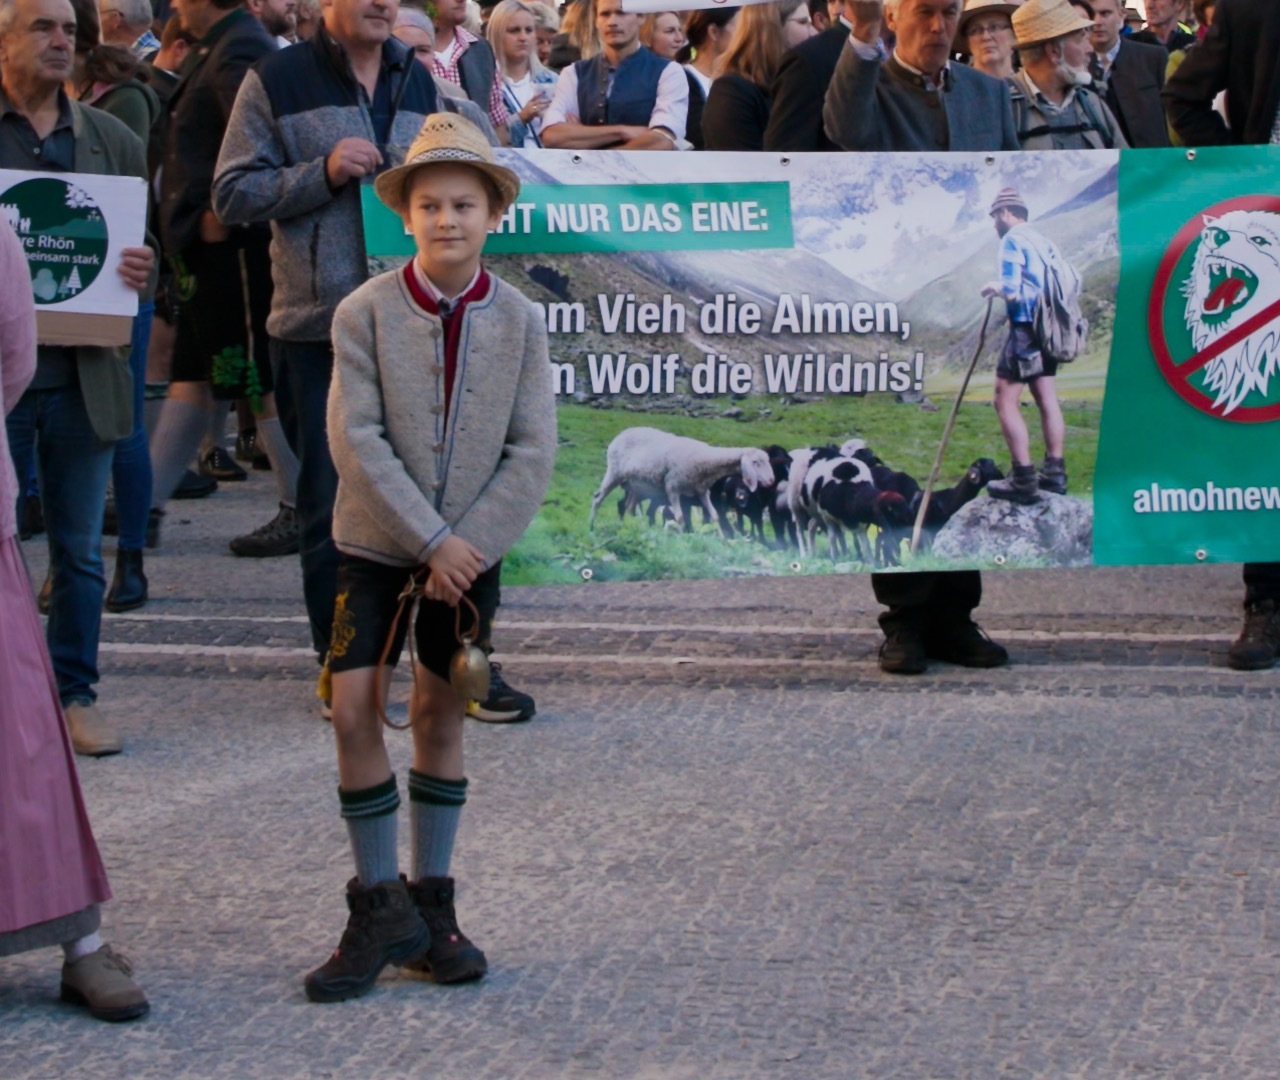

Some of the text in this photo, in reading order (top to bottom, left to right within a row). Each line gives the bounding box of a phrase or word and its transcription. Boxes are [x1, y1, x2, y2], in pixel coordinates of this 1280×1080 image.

[546, 202, 610, 233] NUR
[621, 202, 682, 232] DAS
[690, 201, 769, 232] EINE:
[38, 235, 75, 250] Rhön
[72, 253, 100, 265] stark
[597, 293, 685, 334] Vieh
[700, 293, 761, 334] die
[771, 293, 911, 341] Almen,
[587, 353, 680, 395] Wolf
[691, 354, 752, 395] die
[763, 353, 924, 394] Wildnis!
